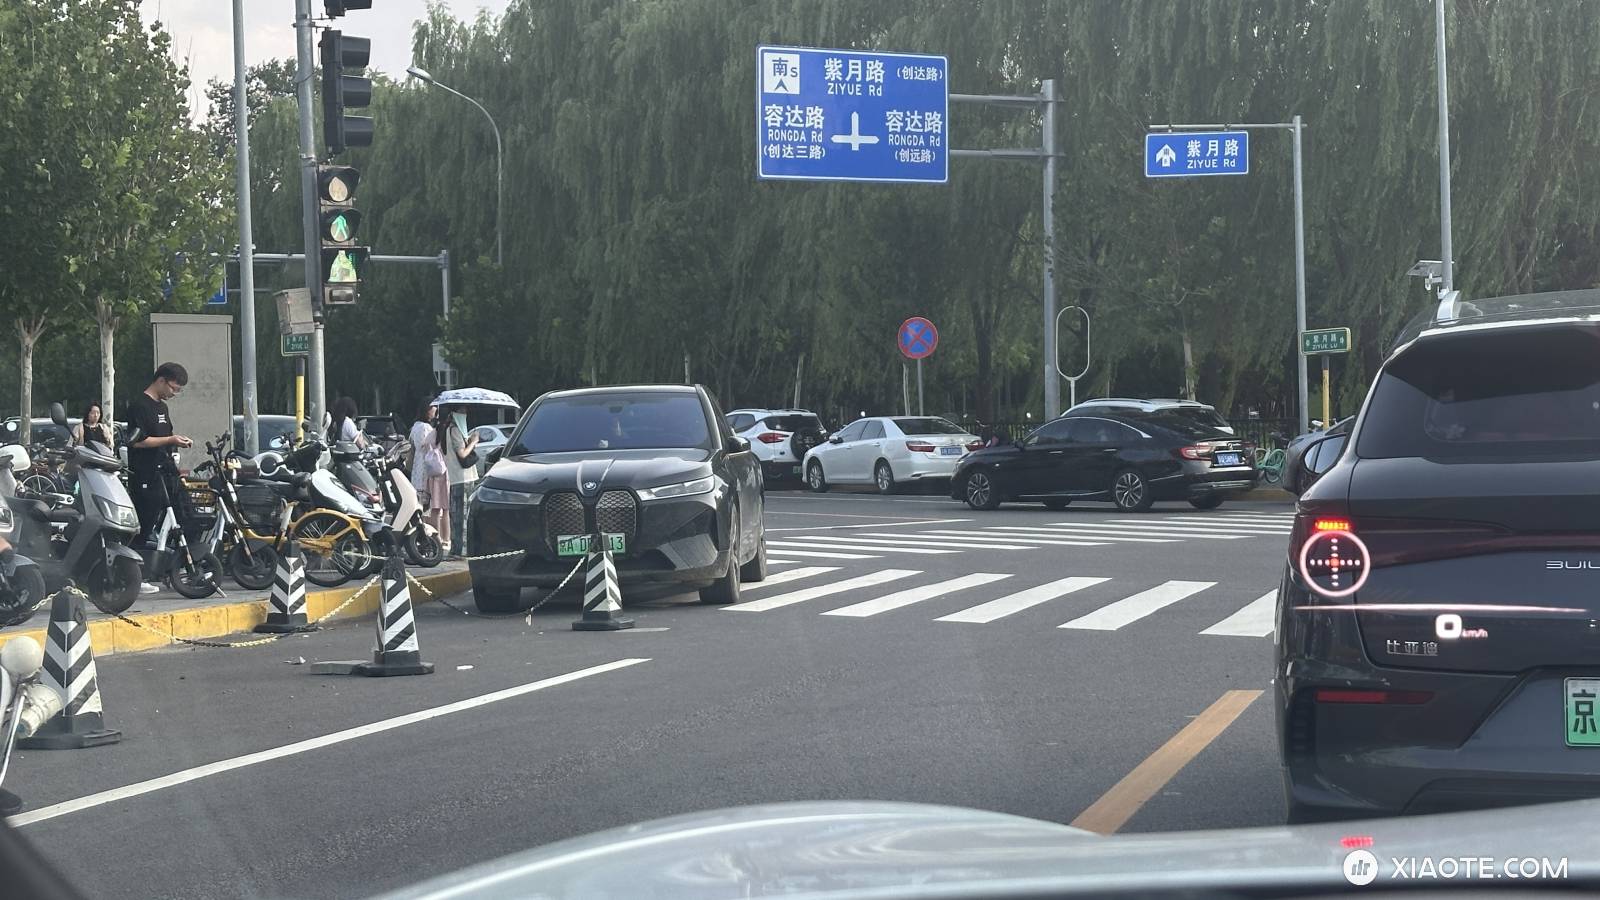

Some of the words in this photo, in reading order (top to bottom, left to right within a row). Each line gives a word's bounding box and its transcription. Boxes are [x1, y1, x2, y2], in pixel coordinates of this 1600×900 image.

[772, 57, 789, 77] 南
[824, 57, 885, 83] 紫月路
[827, 83, 862, 96] ZIYUE
[869, 84, 883, 97] Rd
[764, 104, 825, 129] 容达路
[885, 110, 943, 134] 容达路
[768, 129, 806, 142] RONGDA
[811, 130, 823, 143] Rd
[888, 134, 925, 146] RONGDA
[930, 135, 940, 147] Rd
[1186, 139, 1239, 157] 紫月路
[1187, 159, 1218, 169] ZIYUE
[1223, 158, 1236, 167] Rd
[1572, 689, 1597, 734] 京
